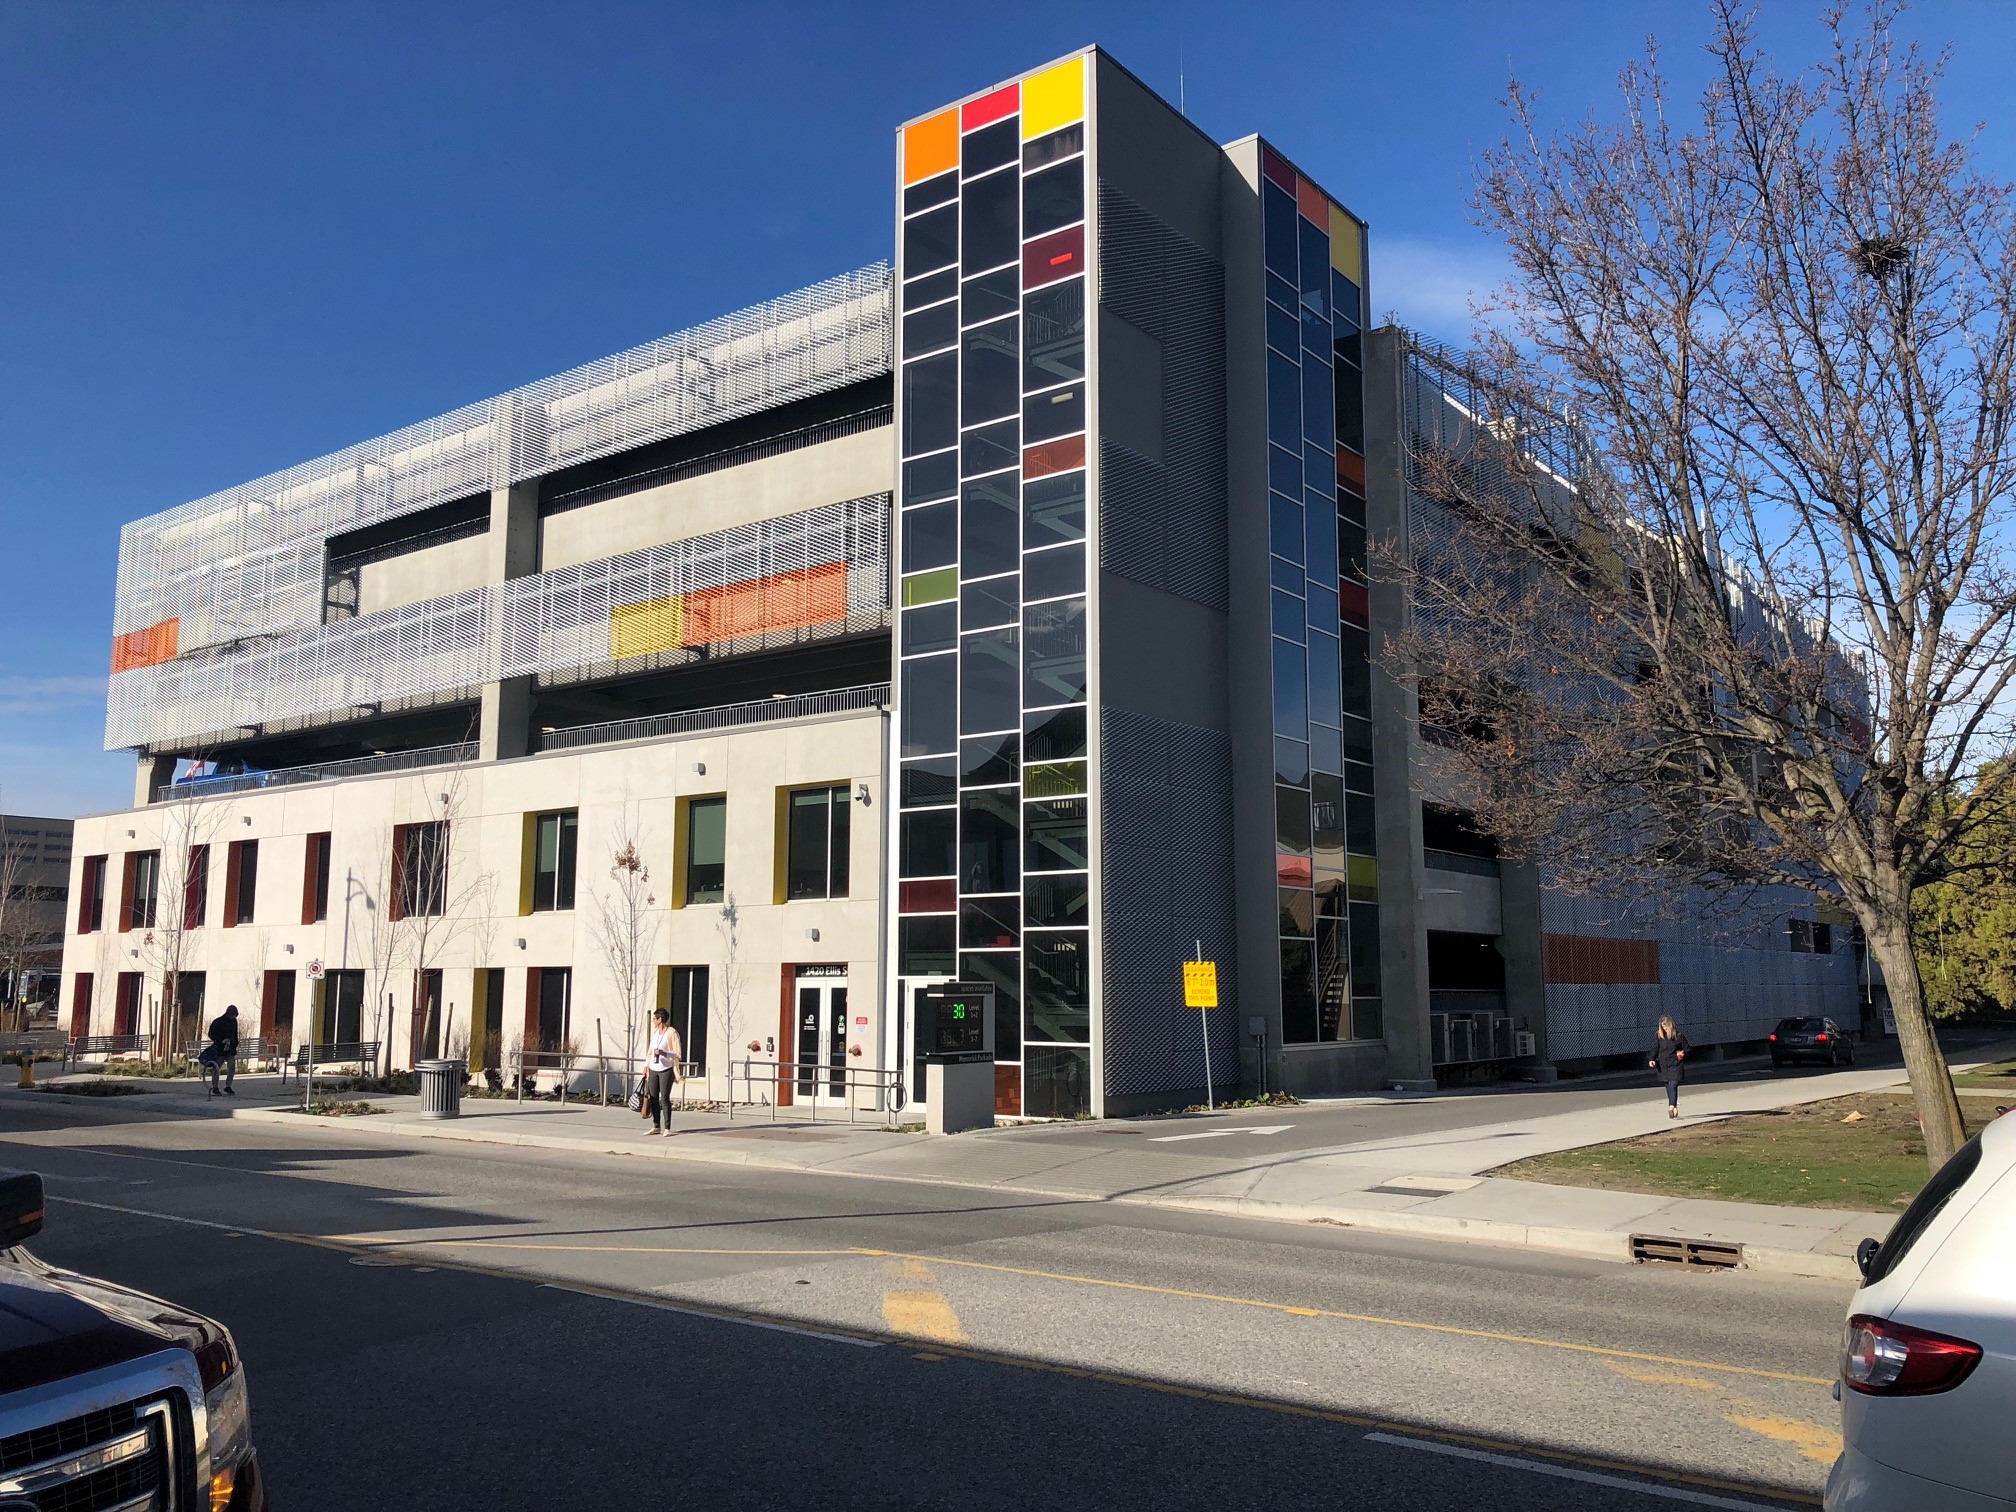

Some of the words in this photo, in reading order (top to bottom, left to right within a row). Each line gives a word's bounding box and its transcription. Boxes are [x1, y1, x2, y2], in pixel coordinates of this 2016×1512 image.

[806, 966, 824, 976] 1420
[825, 966, 841, 976] Ellis
[842, 966, 848, 976] S
[953, 1003, 965, 1019] 30
